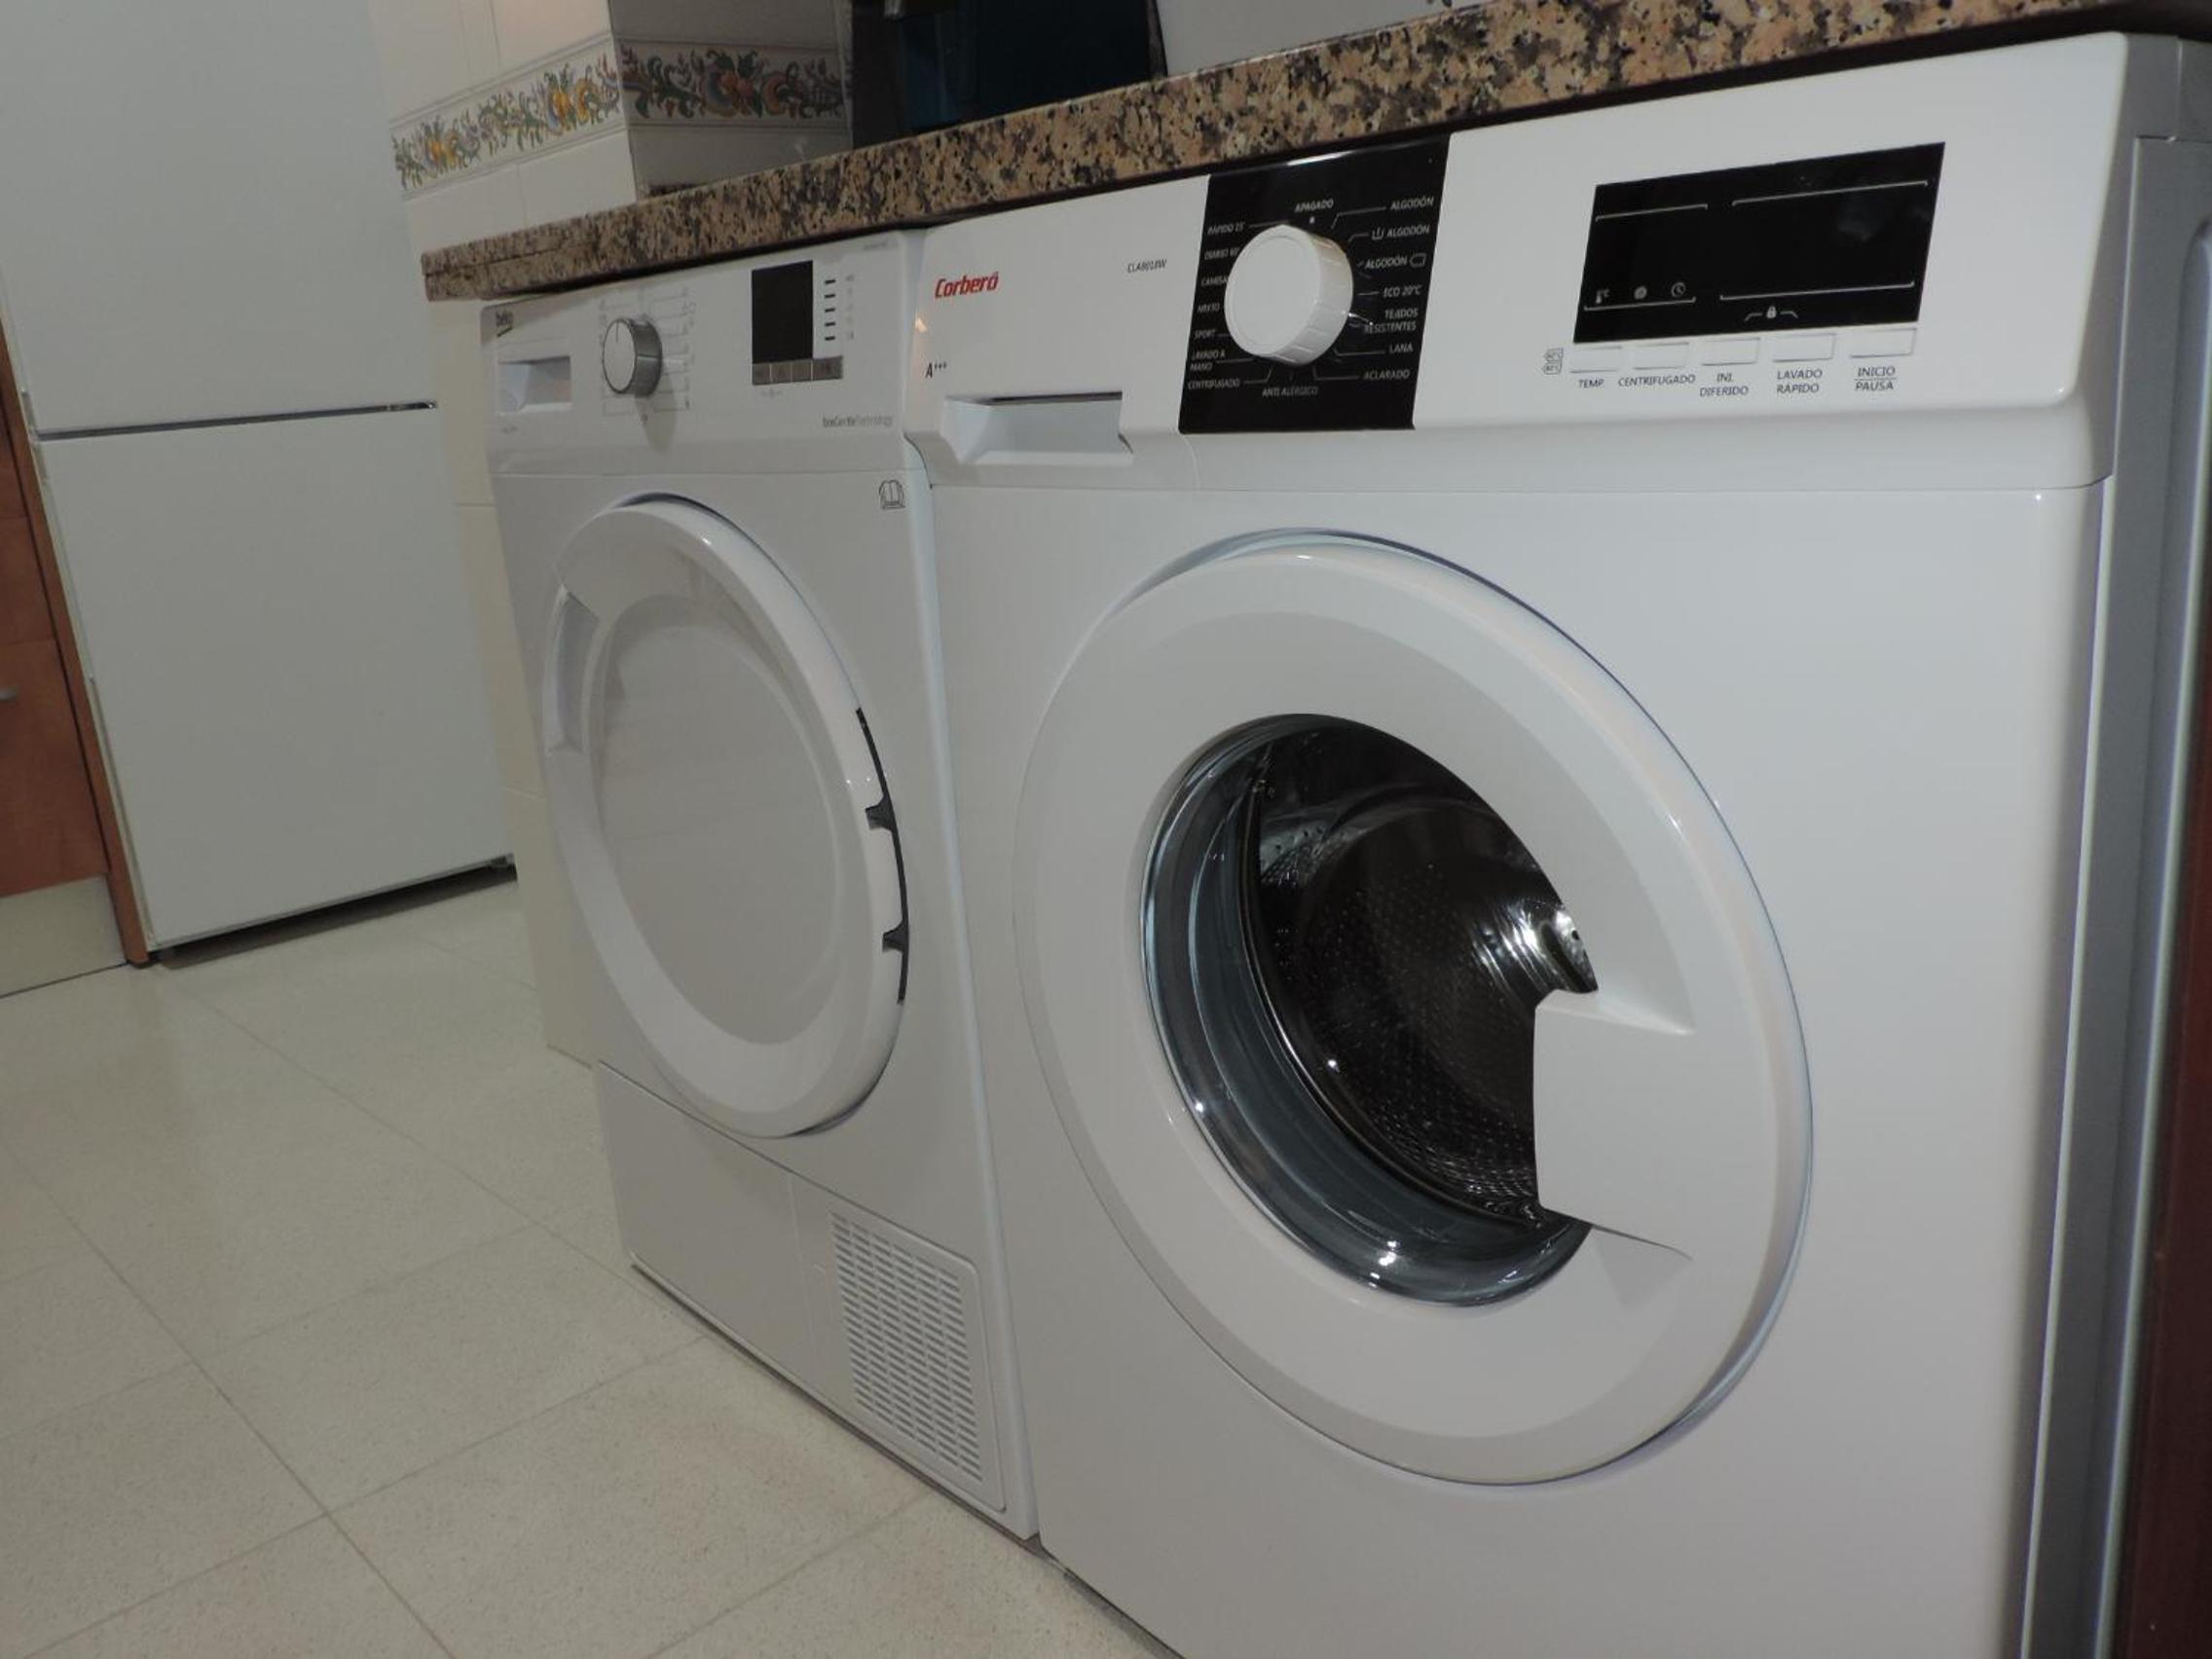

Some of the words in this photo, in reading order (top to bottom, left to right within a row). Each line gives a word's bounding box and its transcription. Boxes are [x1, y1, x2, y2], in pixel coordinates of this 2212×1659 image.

[1294, 198, 1335, 213] APAGADO
[1389, 196, 1435, 210] ALGODÓN
[1386, 225, 1430, 238] ALGODÓN
[1364, 255, 1408, 270] ALGODÓN
[935, 271, 999, 299] Corberó
[1384, 308, 1419, 320] TEJIDOS
[1364, 320, 1417, 335] RESISTENTES
[1388, 342, 1414, 353] LANA
[1363, 369, 1411, 380] ACLARADO
[1777, 368, 1823, 381] LAVADO
[1858, 365, 1896, 378] INICIO
[1617, 373, 1696, 387] CENTRIFUGADO
[1855, 380, 1895, 392] PAUSA
[1699, 386, 1750, 398] DIFERIDO
